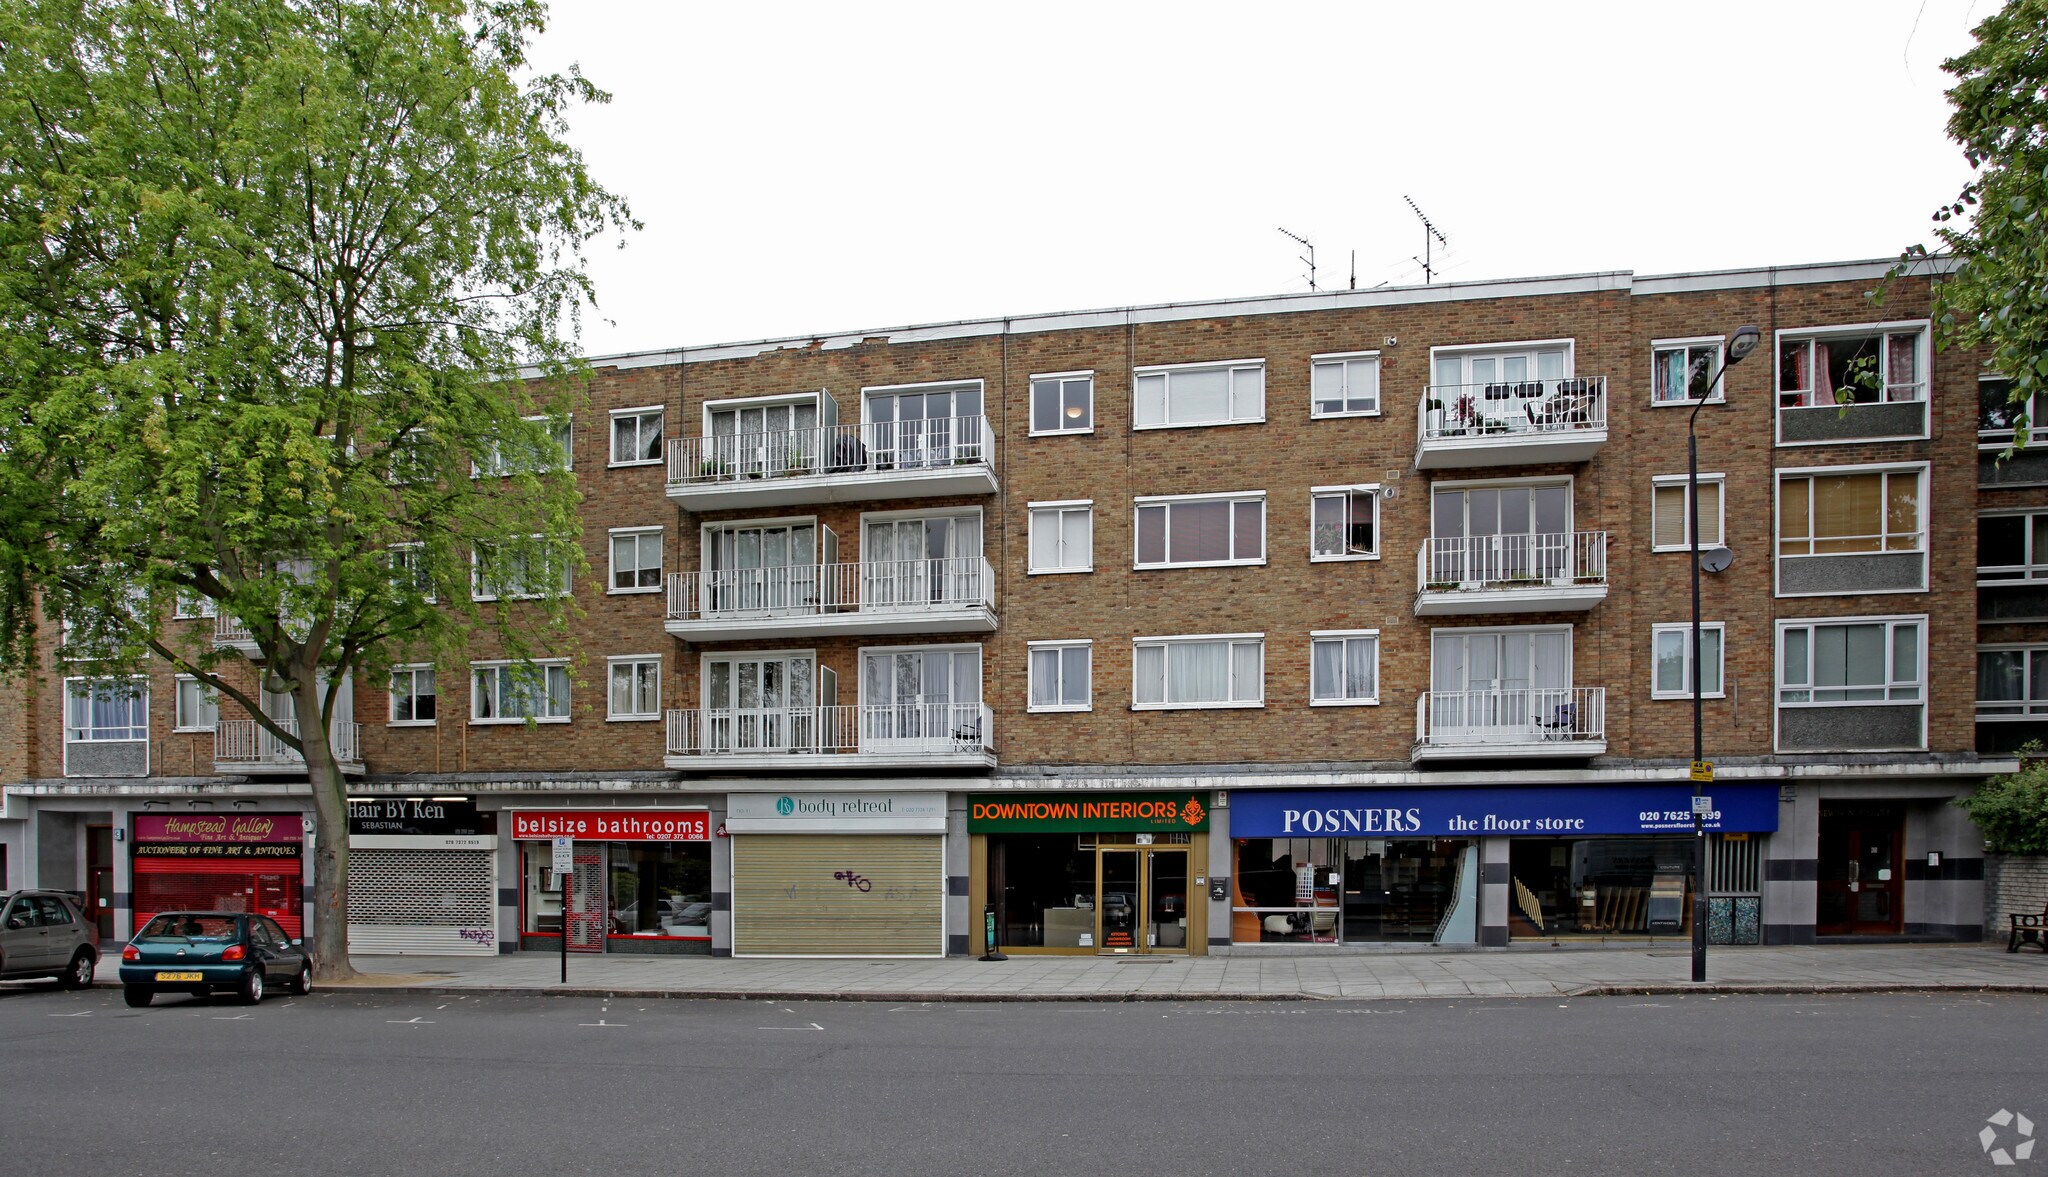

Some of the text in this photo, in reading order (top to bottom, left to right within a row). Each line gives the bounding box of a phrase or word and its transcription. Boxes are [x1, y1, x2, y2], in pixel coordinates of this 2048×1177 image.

[386, 801, 407, 819] BY
[413, 801, 445, 819] Ken
[798, 799, 835, 816] body
[842, 799, 892, 813] retreat
[973, 801, 1176, 819] DOWNTOWN INTERIORS
[1639, 812, 1659, 821] 020
[1663, 811, 1690, 820] 7625
[165, 816, 273, 838] Hampstead Gallery
[518, 817, 704, 833] belsize bathrooms
[1282, 808, 1584, 832] POSNERS the floor store
[136, 846, 296, 856] AUCTIONEERS OF FINE ART & ANTIQUES
